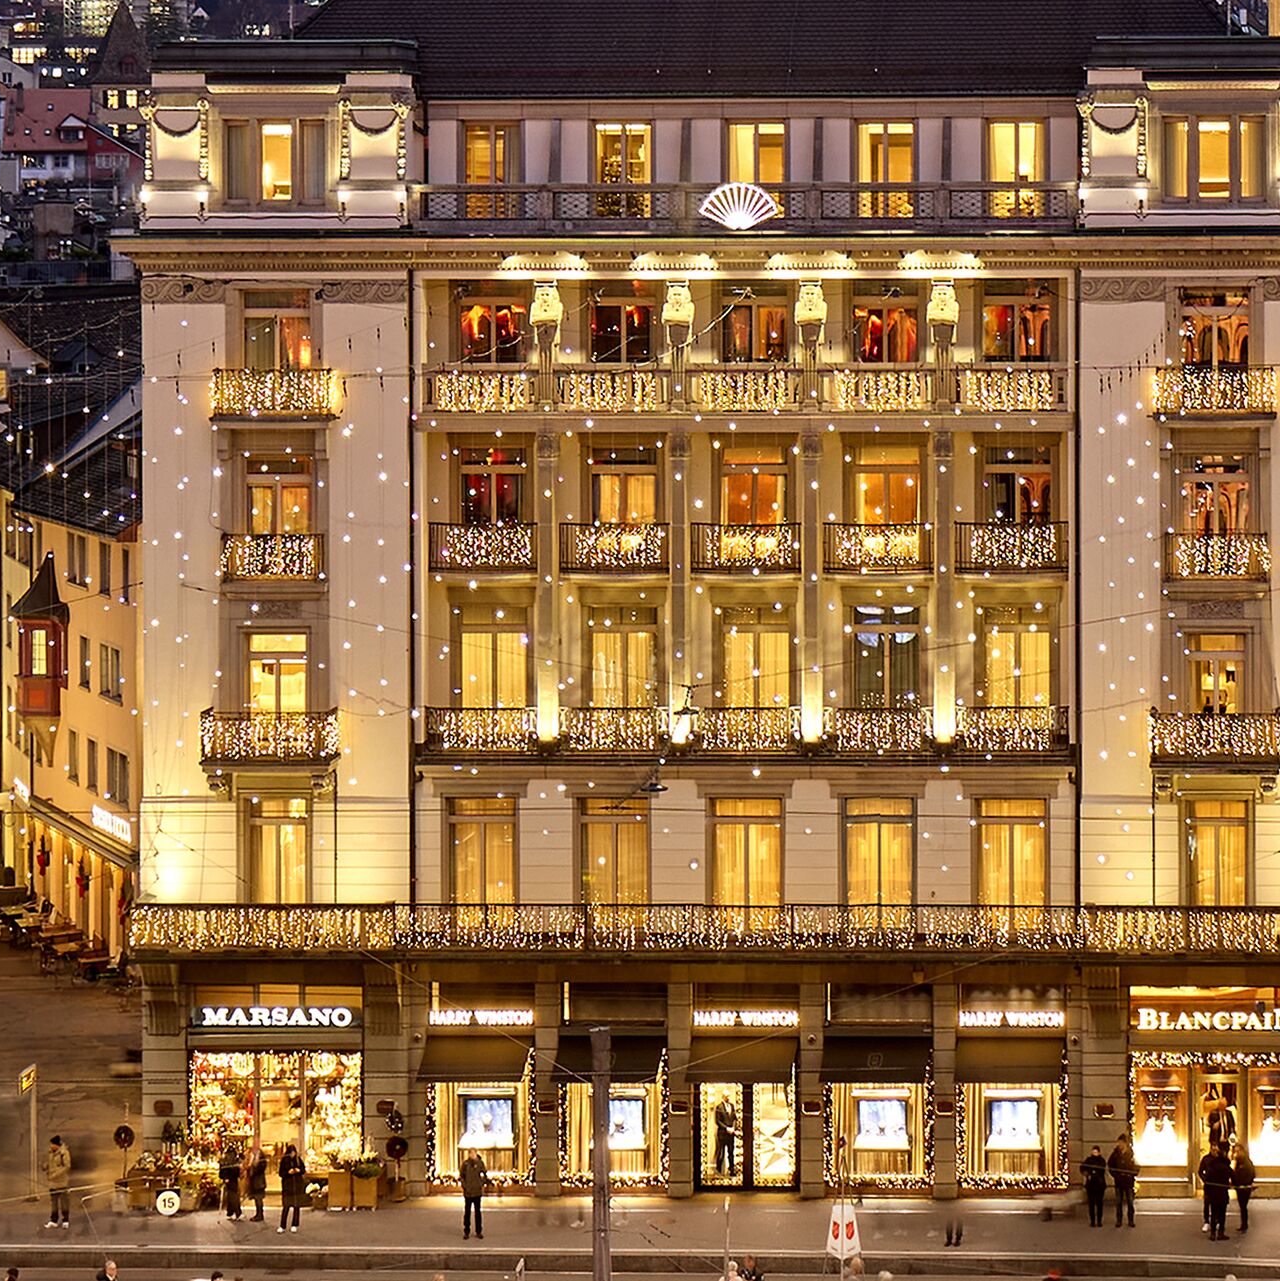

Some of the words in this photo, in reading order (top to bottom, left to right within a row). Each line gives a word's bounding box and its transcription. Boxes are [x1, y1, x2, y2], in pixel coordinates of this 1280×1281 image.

[202, 1007, 352, 1028] MARSANO
[429, 1010, 473, 1025] HARRY
[474, 1010, 534, 1025] WINSTON
[693, 1010, 737, 1025] HARRY
[738, 1010, 798, 1025] WINSTON
[959, 1011, 1003, 1026] HARRY
[1004, 1011, 1064, 1026] WINSTON
[163, 1197, 175, 1209] 15
